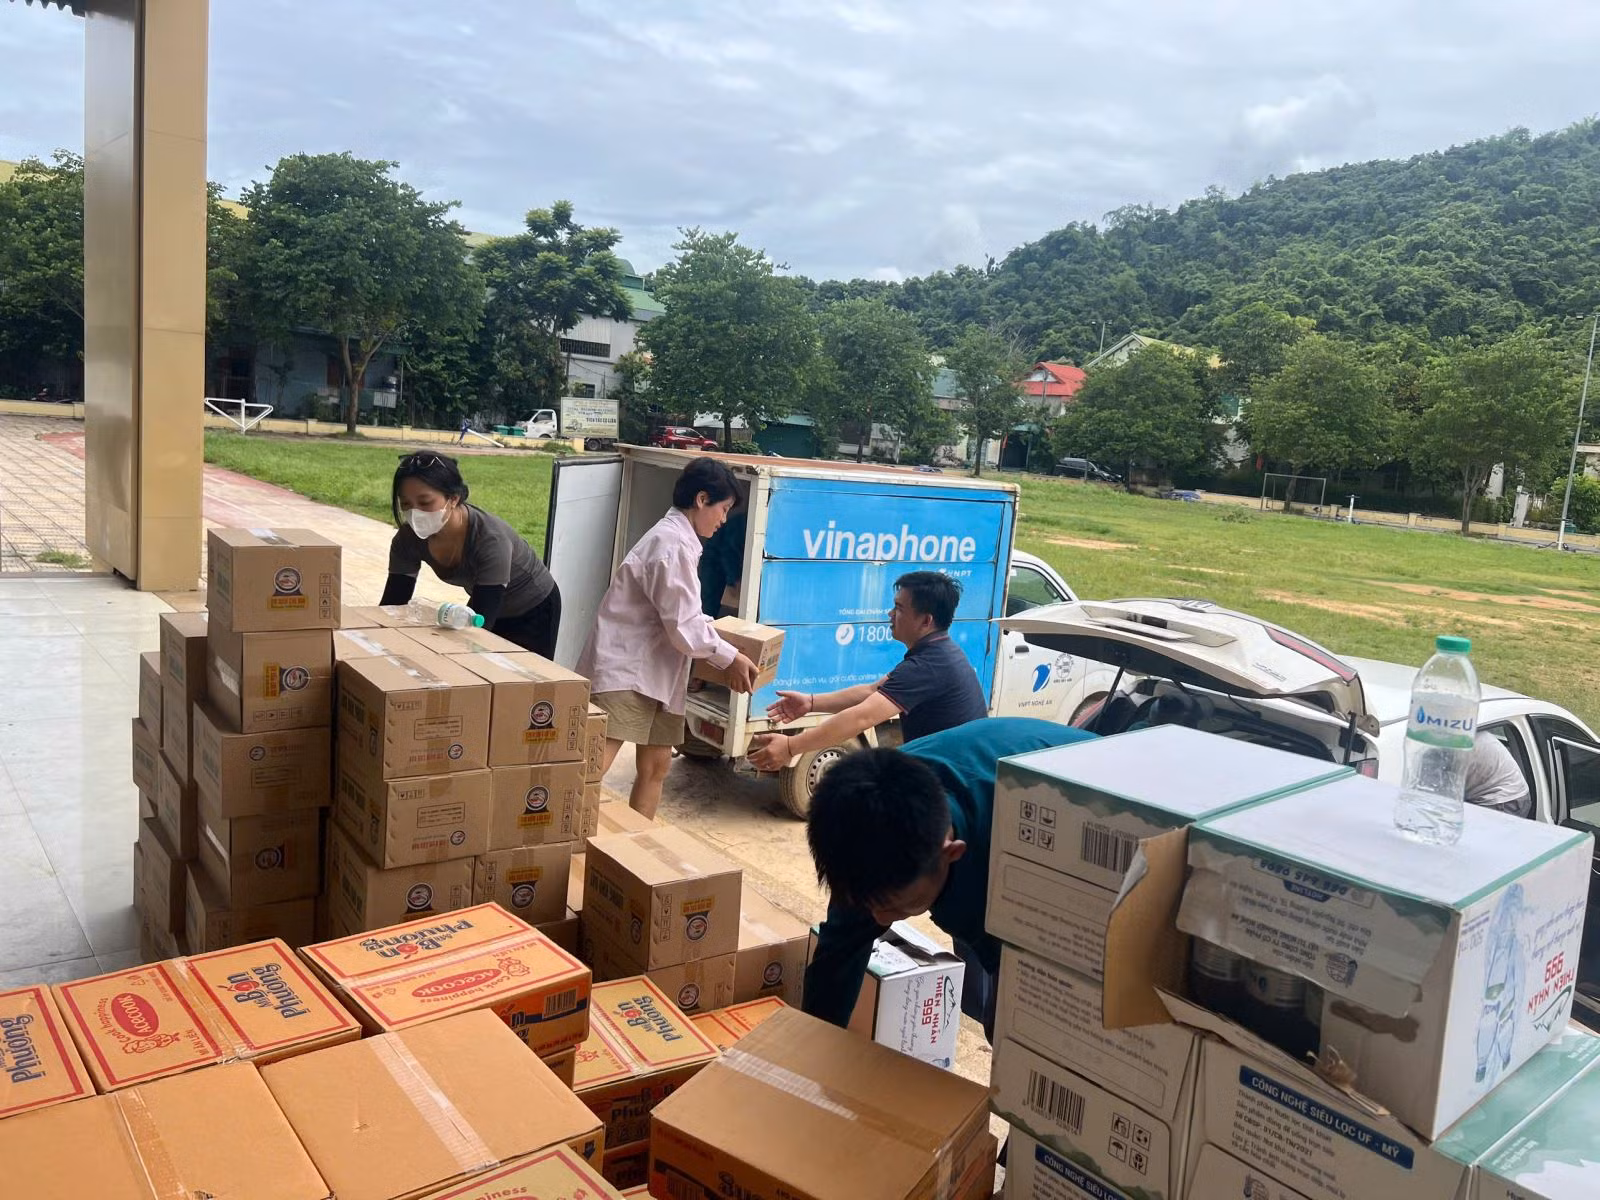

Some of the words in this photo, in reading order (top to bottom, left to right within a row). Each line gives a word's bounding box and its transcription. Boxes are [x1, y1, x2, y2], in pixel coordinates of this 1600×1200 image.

[803, 520, 976, 562] vinaphone
[1427, 715, 1473, 731] MIZU
[360, 919, 474, 953] Phương
[1544, 951, 1563, 982] 999
[252, 962, 311, 1019] Phương
[934, 974, 943, 1006] THIÊN
[633, 994, 683, 1042] Phương
[921, 997, 933, 1025] 999
[0, 1013, 46, 1084] Phương
[1252, 1076, 1279, 1096] CÔNG
[1280, 1090, 1308, 1112] NGHỆ
[1309, 1104, 1333, 1124] SIÊU
[1334, 1118, 1356, 1137] LỌC
[1358, 1130, 1371, 1144] UF
[1381, 1141, 1399, 1158] MỸ
